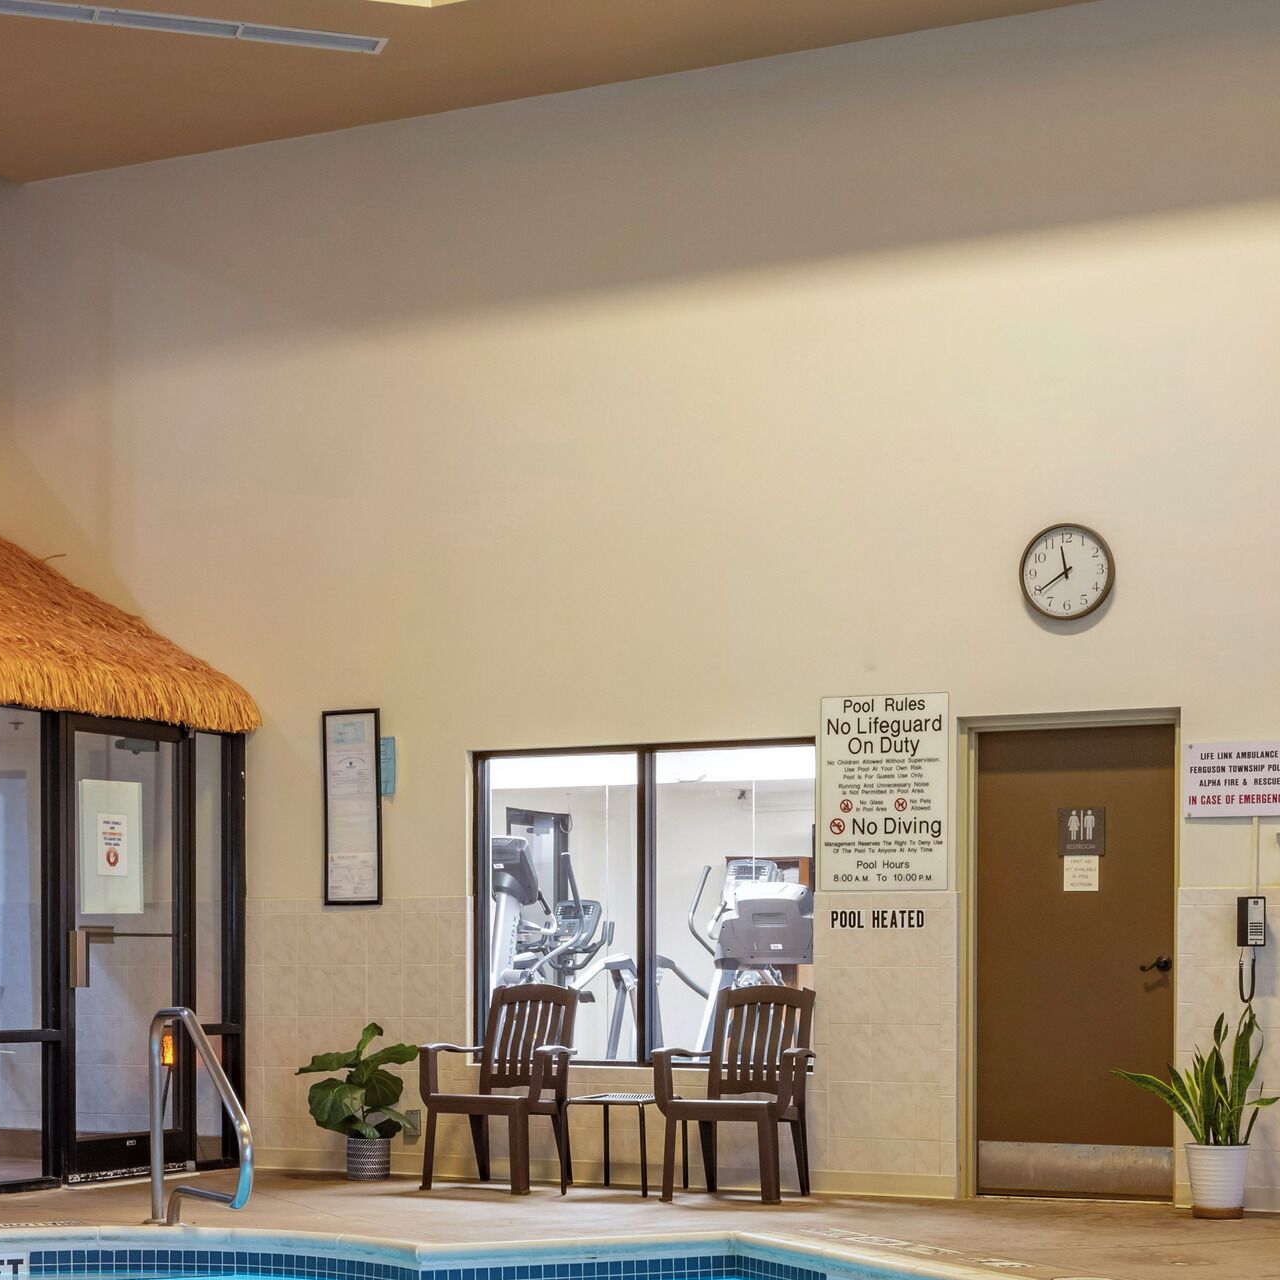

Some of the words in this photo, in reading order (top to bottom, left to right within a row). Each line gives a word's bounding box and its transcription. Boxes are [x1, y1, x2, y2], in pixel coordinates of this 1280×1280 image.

[1062, 532, 1072, 543] 12
[1082, 536, 1084, 546] 1
[1045, 538, 1054, 549] 11
[1092, 547, 1099, 557] 2
[1035, 552, 1046, 563] 10
[1029, 569, 1037, 579] 9
[1097, 564, 1104, 574] 3
[1034, 585, 1041, 596] 8
[1092, 581, 1100, 591] 4
[1047, 597, 1054, 607] 7
[1080, 594, 1088, 605] 5
[1063, 600, 1071, 610] 6
[843, 699, 874, 713] Pool
[885, 697, 925, 711] Rules
[827, 718, 851, 735] No
[857, 714, 942, 737] Lifeguard
[848, 737, 873, 754] On
[880, 737, 920, 757] Duty
[1236, 751, 1278, 759] AMBULANCE
[1229, 765, 1265, 773] TOWNSHIP
[1199, 779, 1221, 787] ALPHA
[1254, 777, 1280, 785] RESCUE
[1189, 796, 1197, 805] IN
[1201, 795, 1221, 805] CASE
[1225, 795, 1235, 804] OF
[852, 818, 877, 835] No
[884, 817, 942, 838] Diving
[857, 861, 876, 869] Pool
[833, 874, 852, 882] 8:00
[894, 873, 917, 881] 10:00
[831, 910, 864, 928] POOL
[872, 910, 924, 928] HEATED
[508, 916, 517, 965] MATRIX
